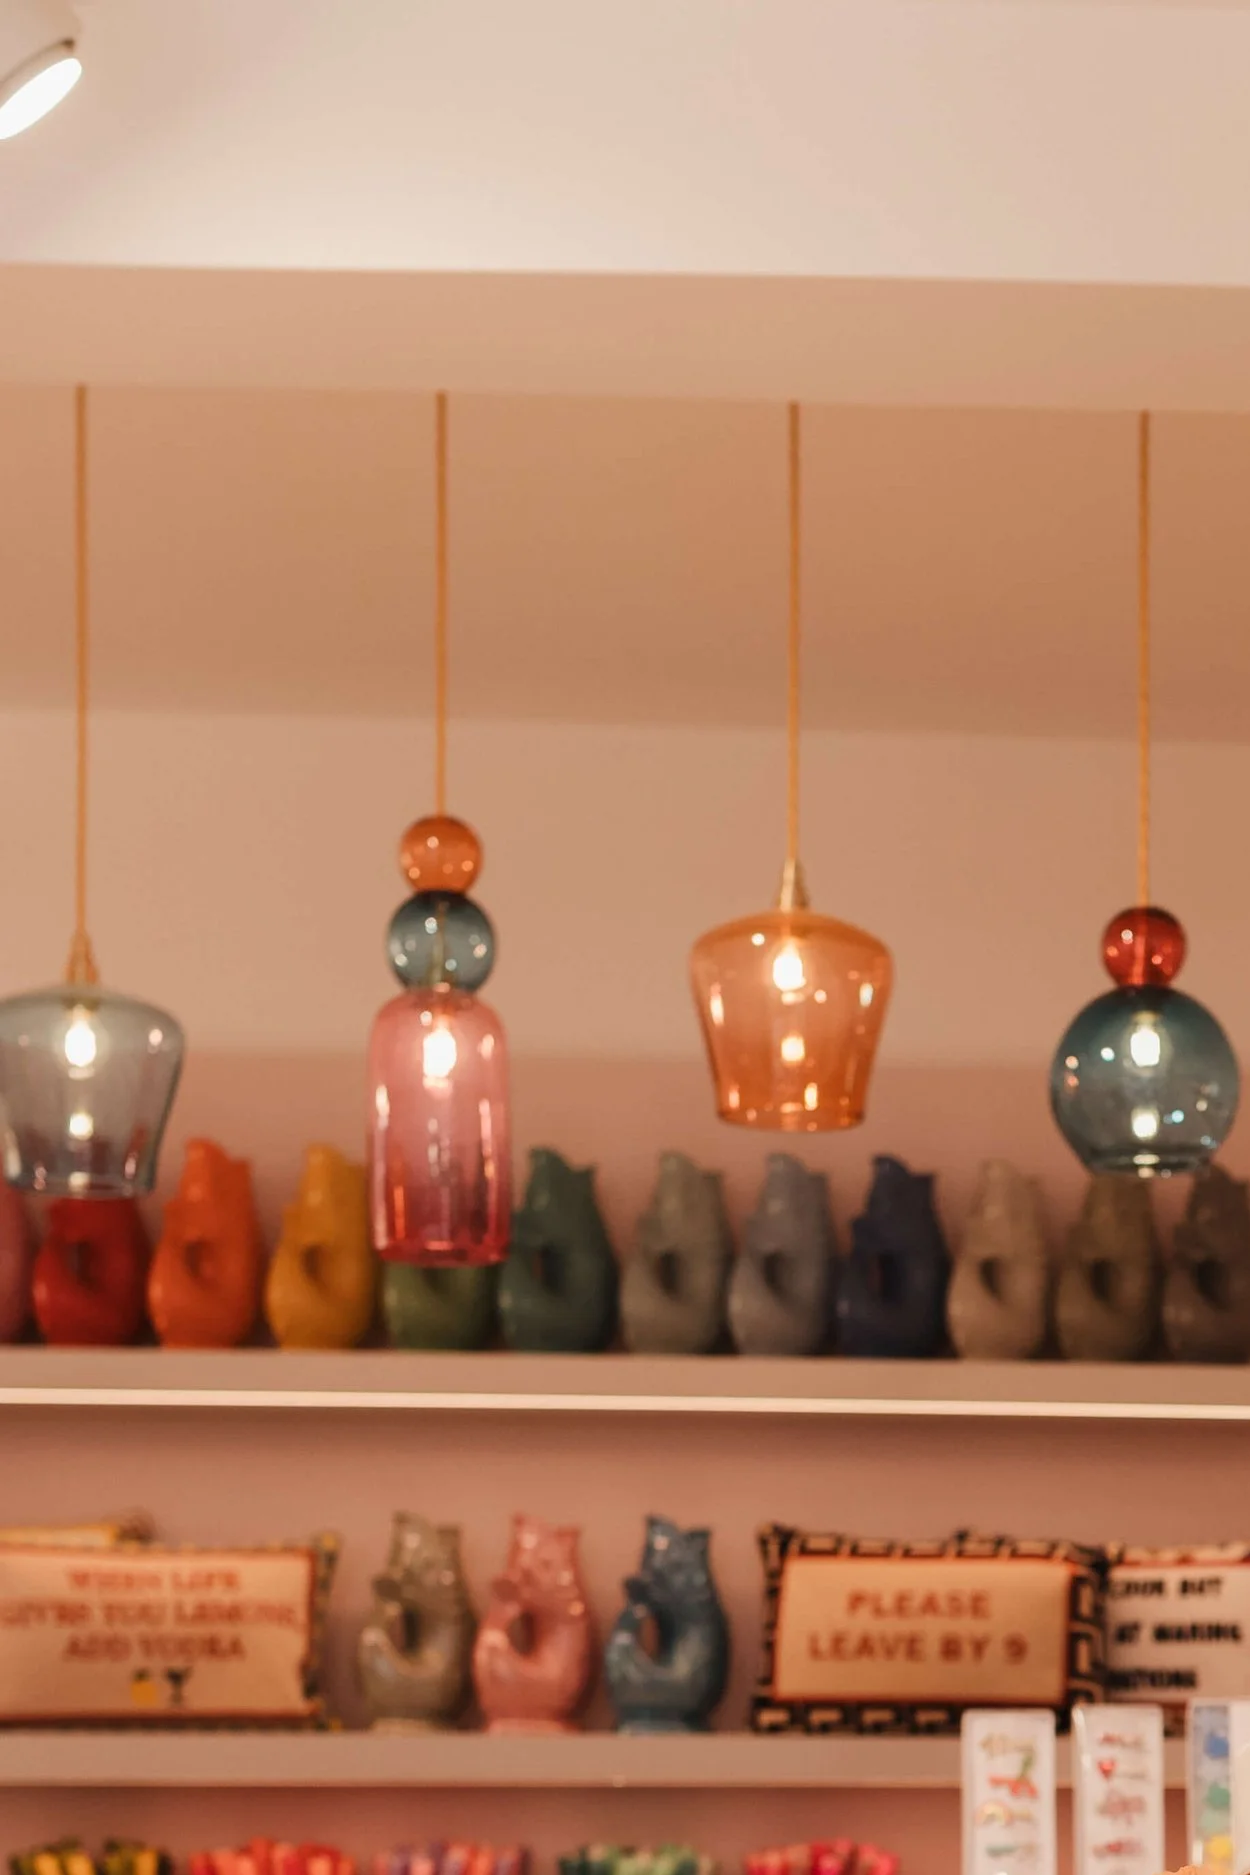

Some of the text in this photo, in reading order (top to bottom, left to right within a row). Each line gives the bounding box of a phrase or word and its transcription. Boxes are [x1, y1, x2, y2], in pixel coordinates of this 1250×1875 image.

[847, 1589, 991, 1620] PLEASE
[808, 1631, 1030, 1665] LEAVE BY 9
